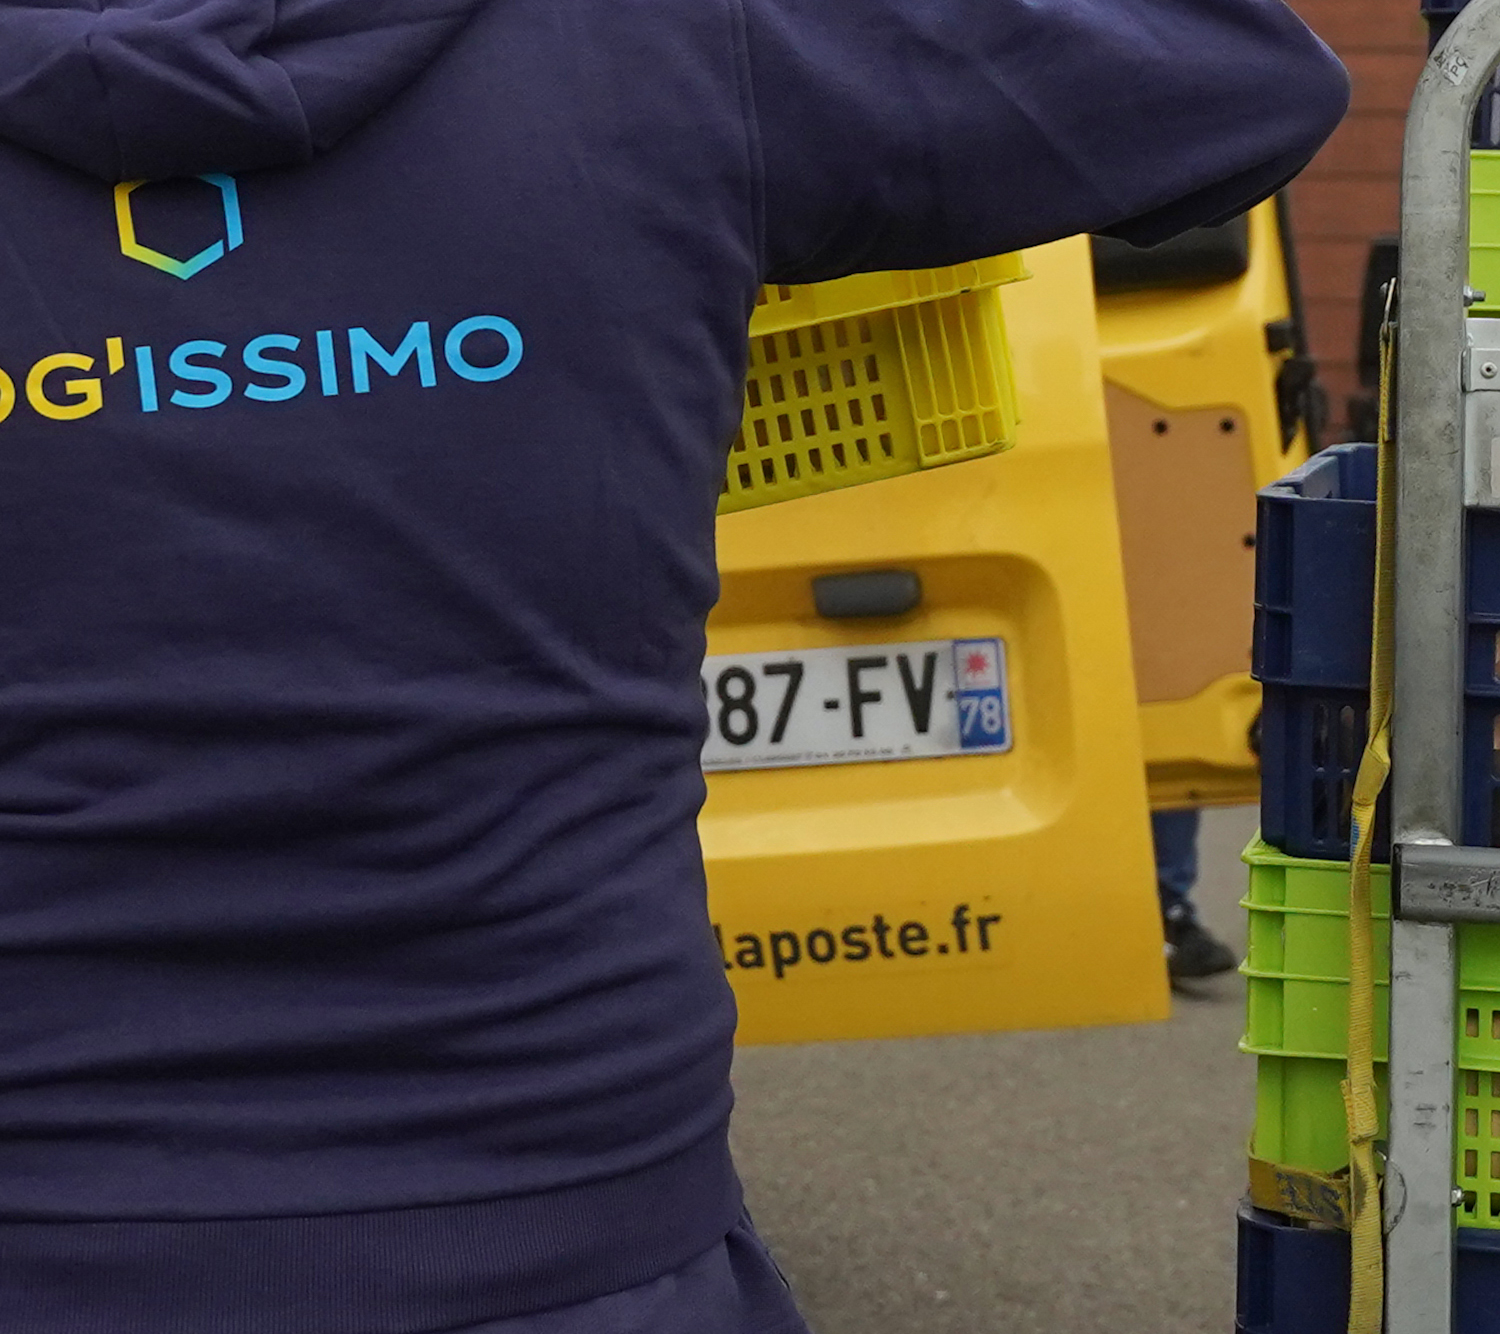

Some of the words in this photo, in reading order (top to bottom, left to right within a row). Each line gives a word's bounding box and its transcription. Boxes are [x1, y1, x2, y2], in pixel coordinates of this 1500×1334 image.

[701, 650, 938, 746] 87-FV
[959, 695, 1002, 736] 78
[713, 903, 1003, 980] laposte.fr
